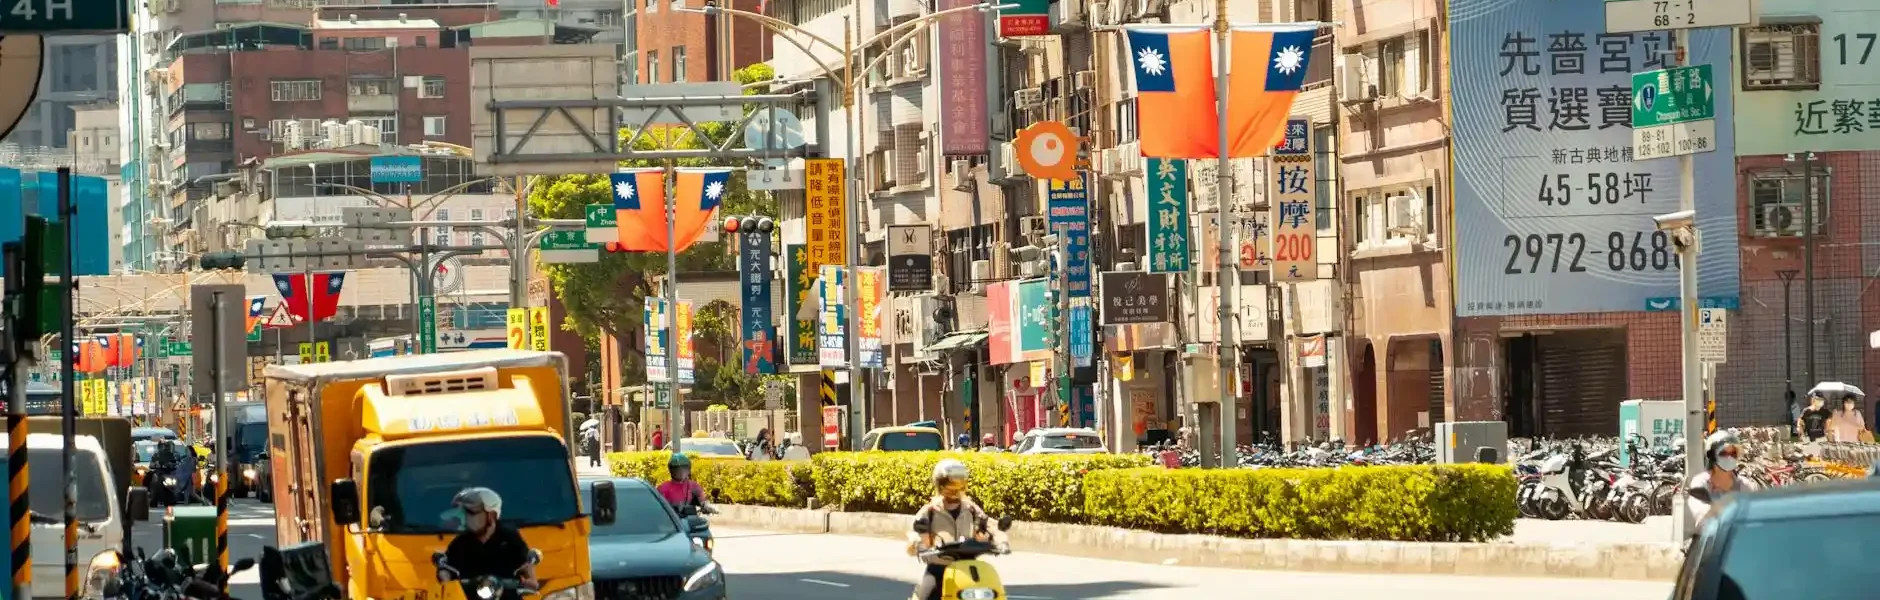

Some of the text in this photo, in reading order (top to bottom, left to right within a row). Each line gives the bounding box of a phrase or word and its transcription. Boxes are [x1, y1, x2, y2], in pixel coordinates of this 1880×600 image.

[1500, 31, 1677, 76] 先嗇宮站
[1658, 68, 1702, 95] 重新路
[1501, 86, 1633, 133] 質選寶
[1551, 147, 1634, 164] 新古典地標
[1277, 165, 1311, 230] 按摩
[1538, 172, 1653, 206] 45-58坪
[1276, 233, 1312, 262] 200
[1504, 231, 1682, 275] 2972-868
